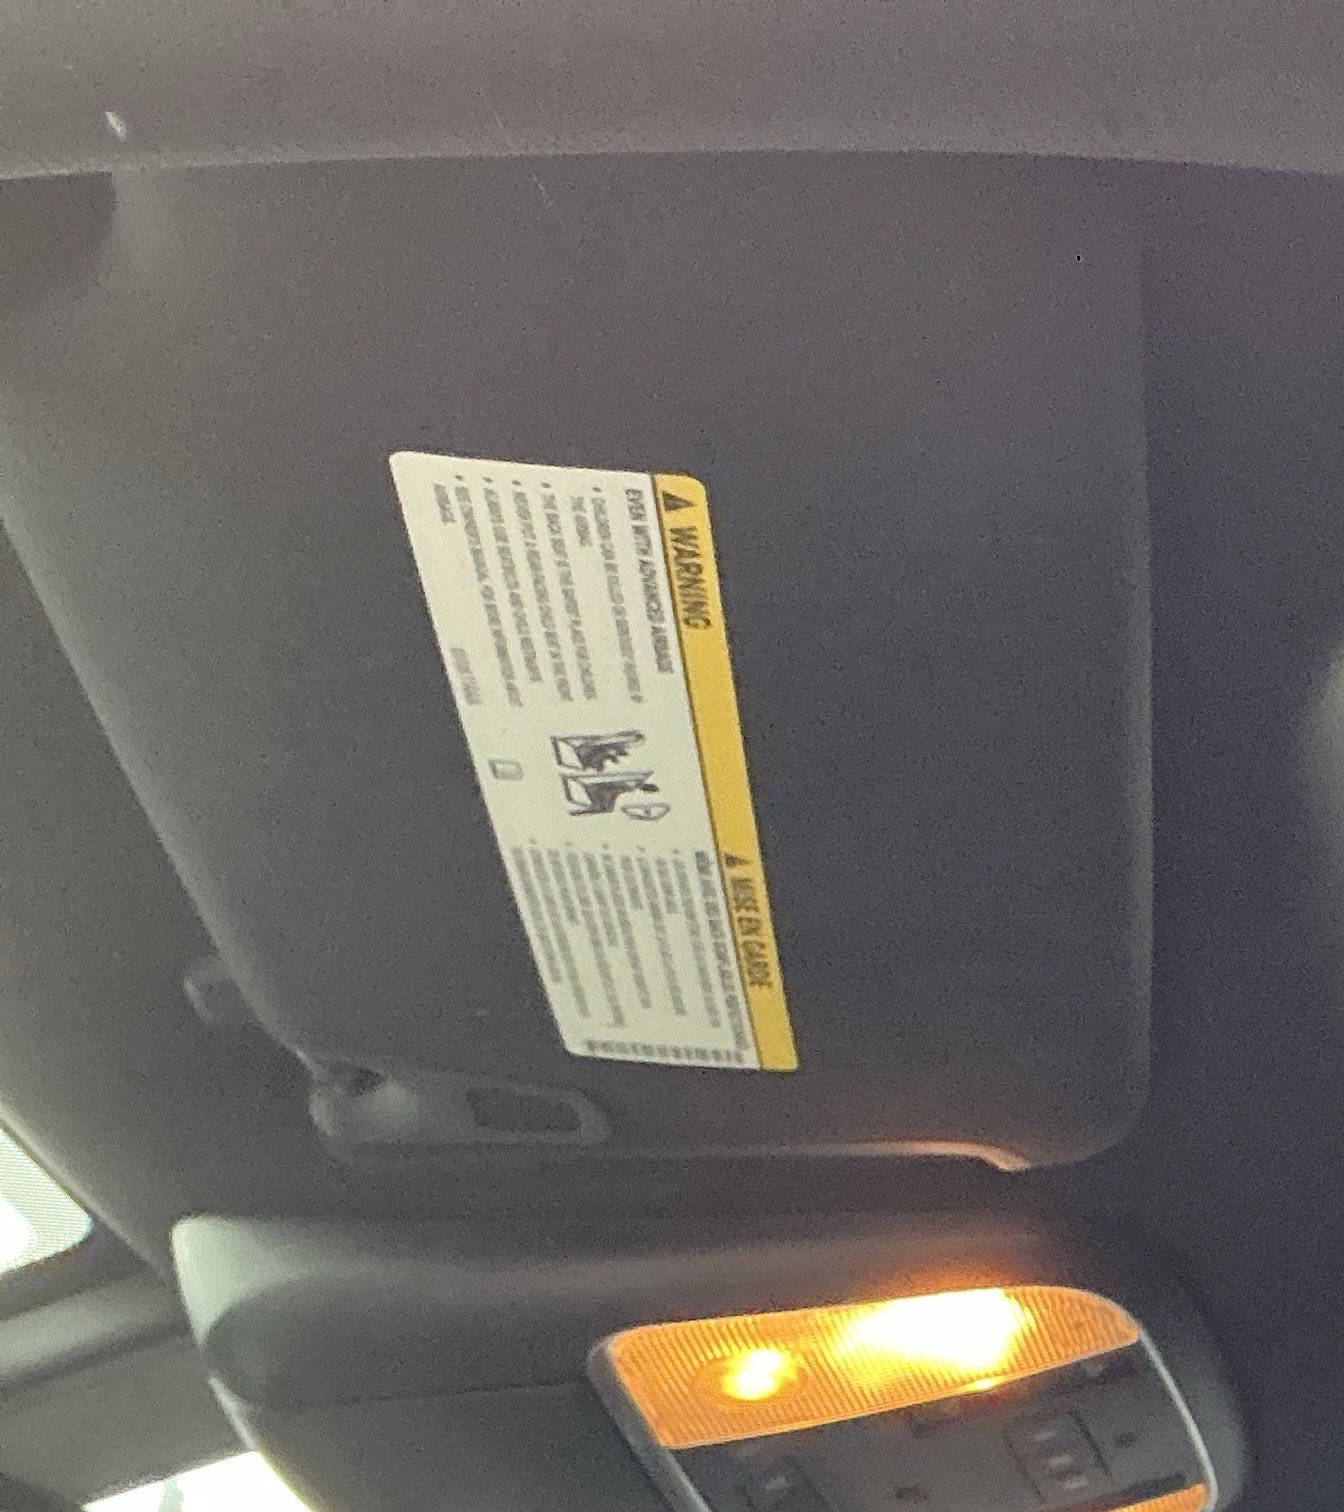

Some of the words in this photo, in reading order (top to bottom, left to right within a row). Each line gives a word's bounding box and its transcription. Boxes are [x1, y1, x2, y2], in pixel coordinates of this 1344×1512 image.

[625, 488, 646, 521] EVEN
[638, 558, 665, 624] ADVANCED
[669, 526, 712, 629] WARNING
[729, 876, 760, 912] MISE
[736, 915, 763, 938] EN
[741, 938, 774, 989] GARDE
